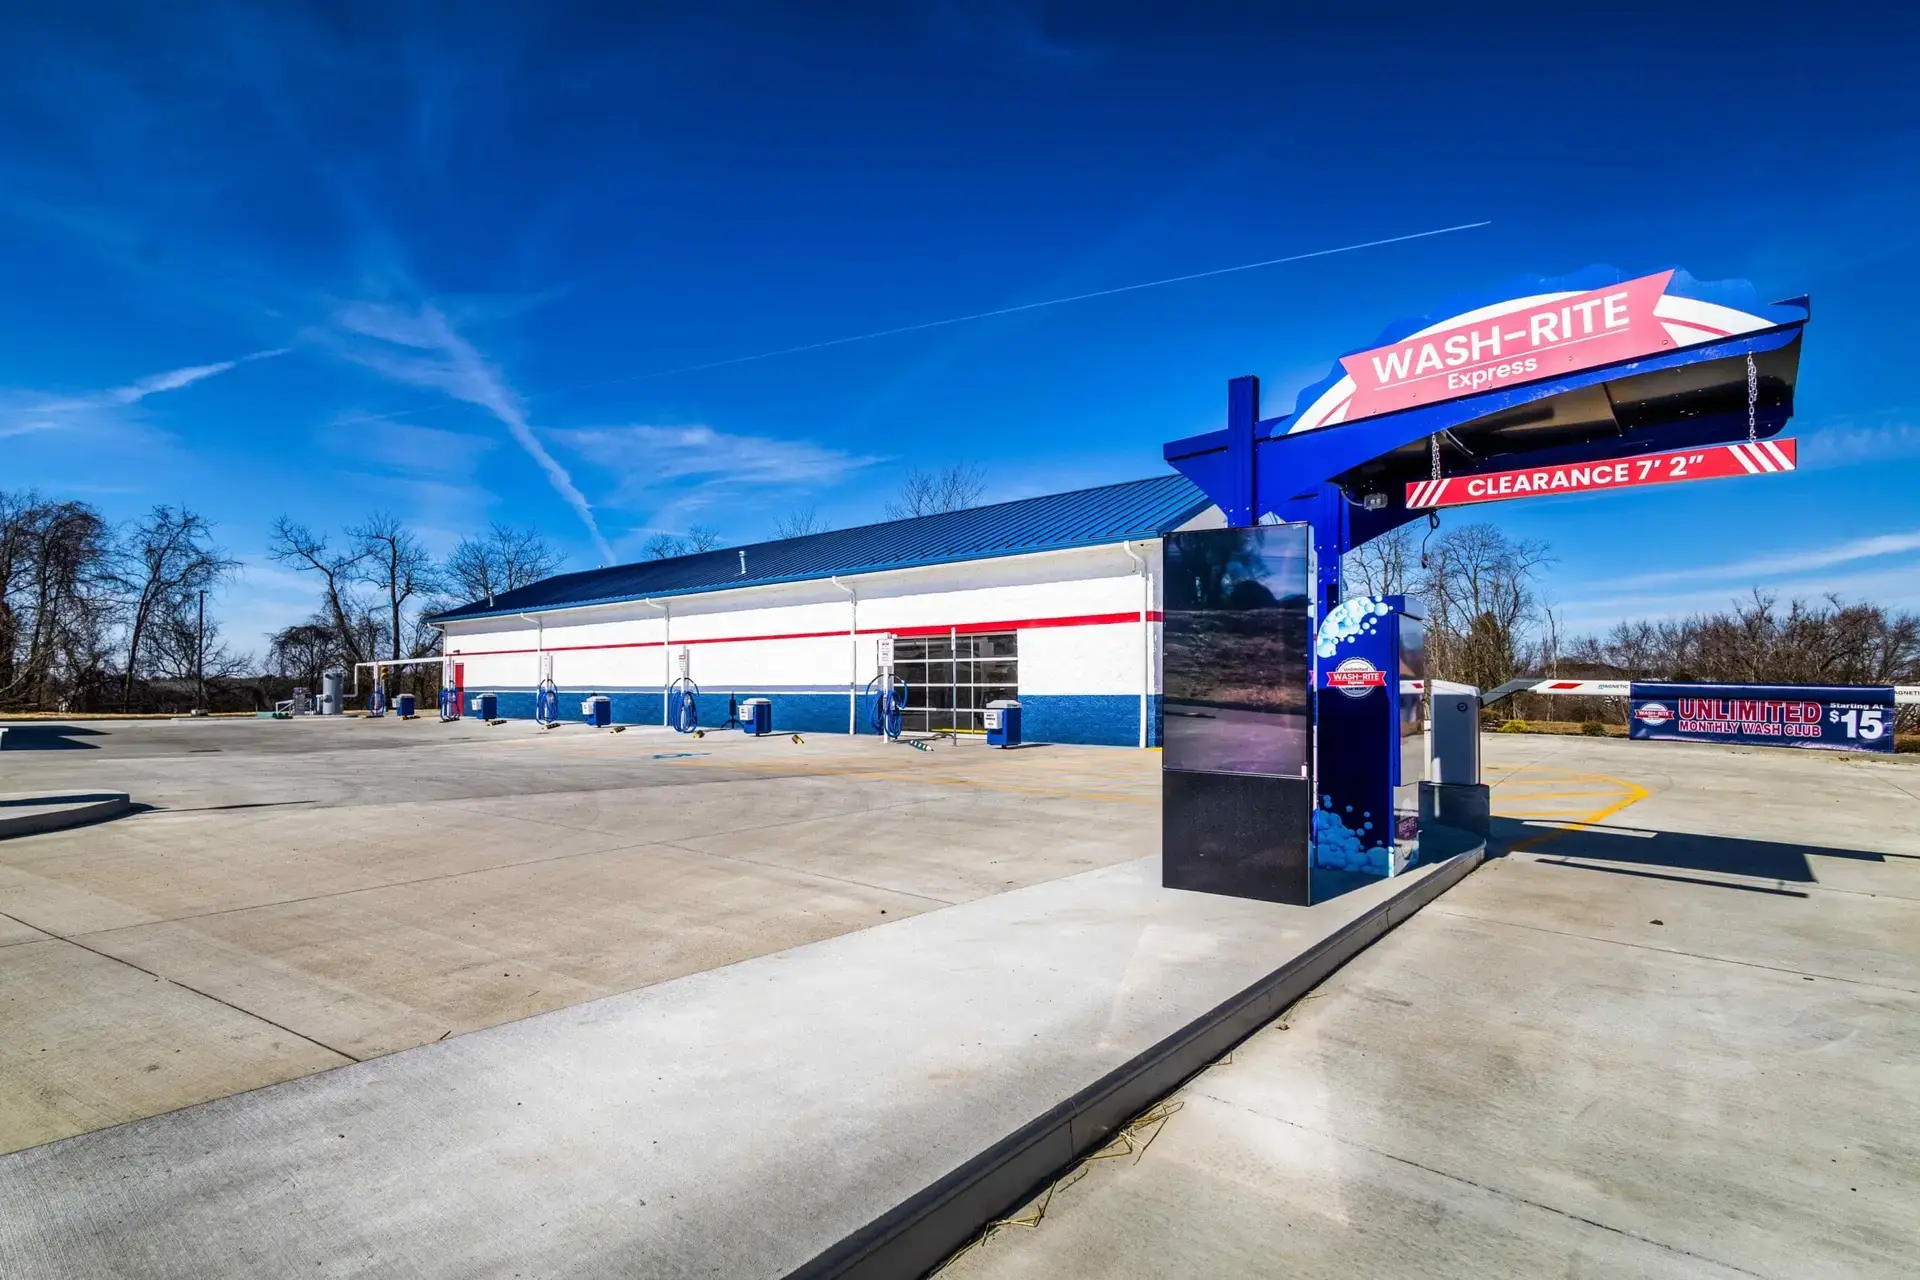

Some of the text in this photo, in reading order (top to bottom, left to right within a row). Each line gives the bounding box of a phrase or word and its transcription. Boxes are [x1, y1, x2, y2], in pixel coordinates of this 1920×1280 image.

[1372, 292, 1629, 383] WASH-RITE
[1448, 358, 1538, 390] Express
[1467, 463, 1629, 496] CLEARANCE
[1679, 698, 1822, 724] UNLIMITED
[1830, 702, 1869, 711] Starting
[1679, 720, 1822, 737] MONTHLY WASH CLUB
[1829, 709, 1884, 739] $15
